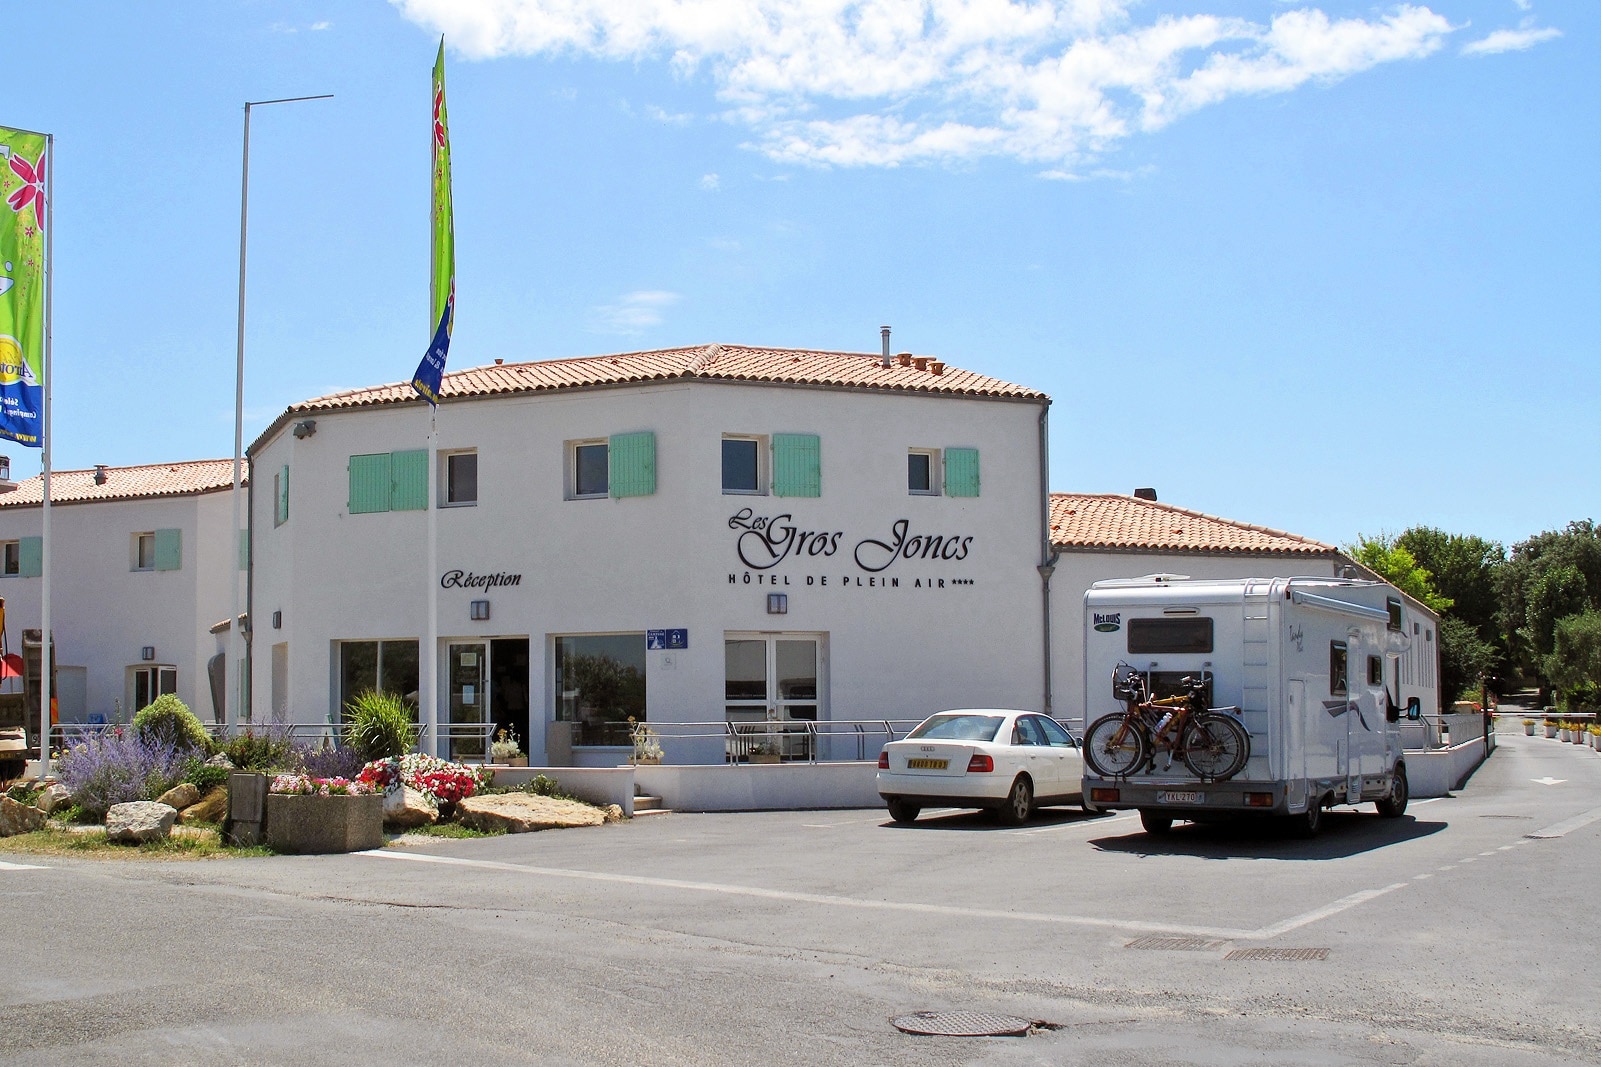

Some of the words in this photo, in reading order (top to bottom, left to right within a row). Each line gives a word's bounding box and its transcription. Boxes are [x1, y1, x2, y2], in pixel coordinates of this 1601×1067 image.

[728, 507, 768, 529] Les
[737, 514, 843, 570] Gros
[854, 519, 974, 572] Joncs
[440, 569, 522, 593] Réception
[728, 571, 790, 585] HÔTEL
[807, 576, 827, 586] DE
[843, 576, 899, 587] PLEIN
